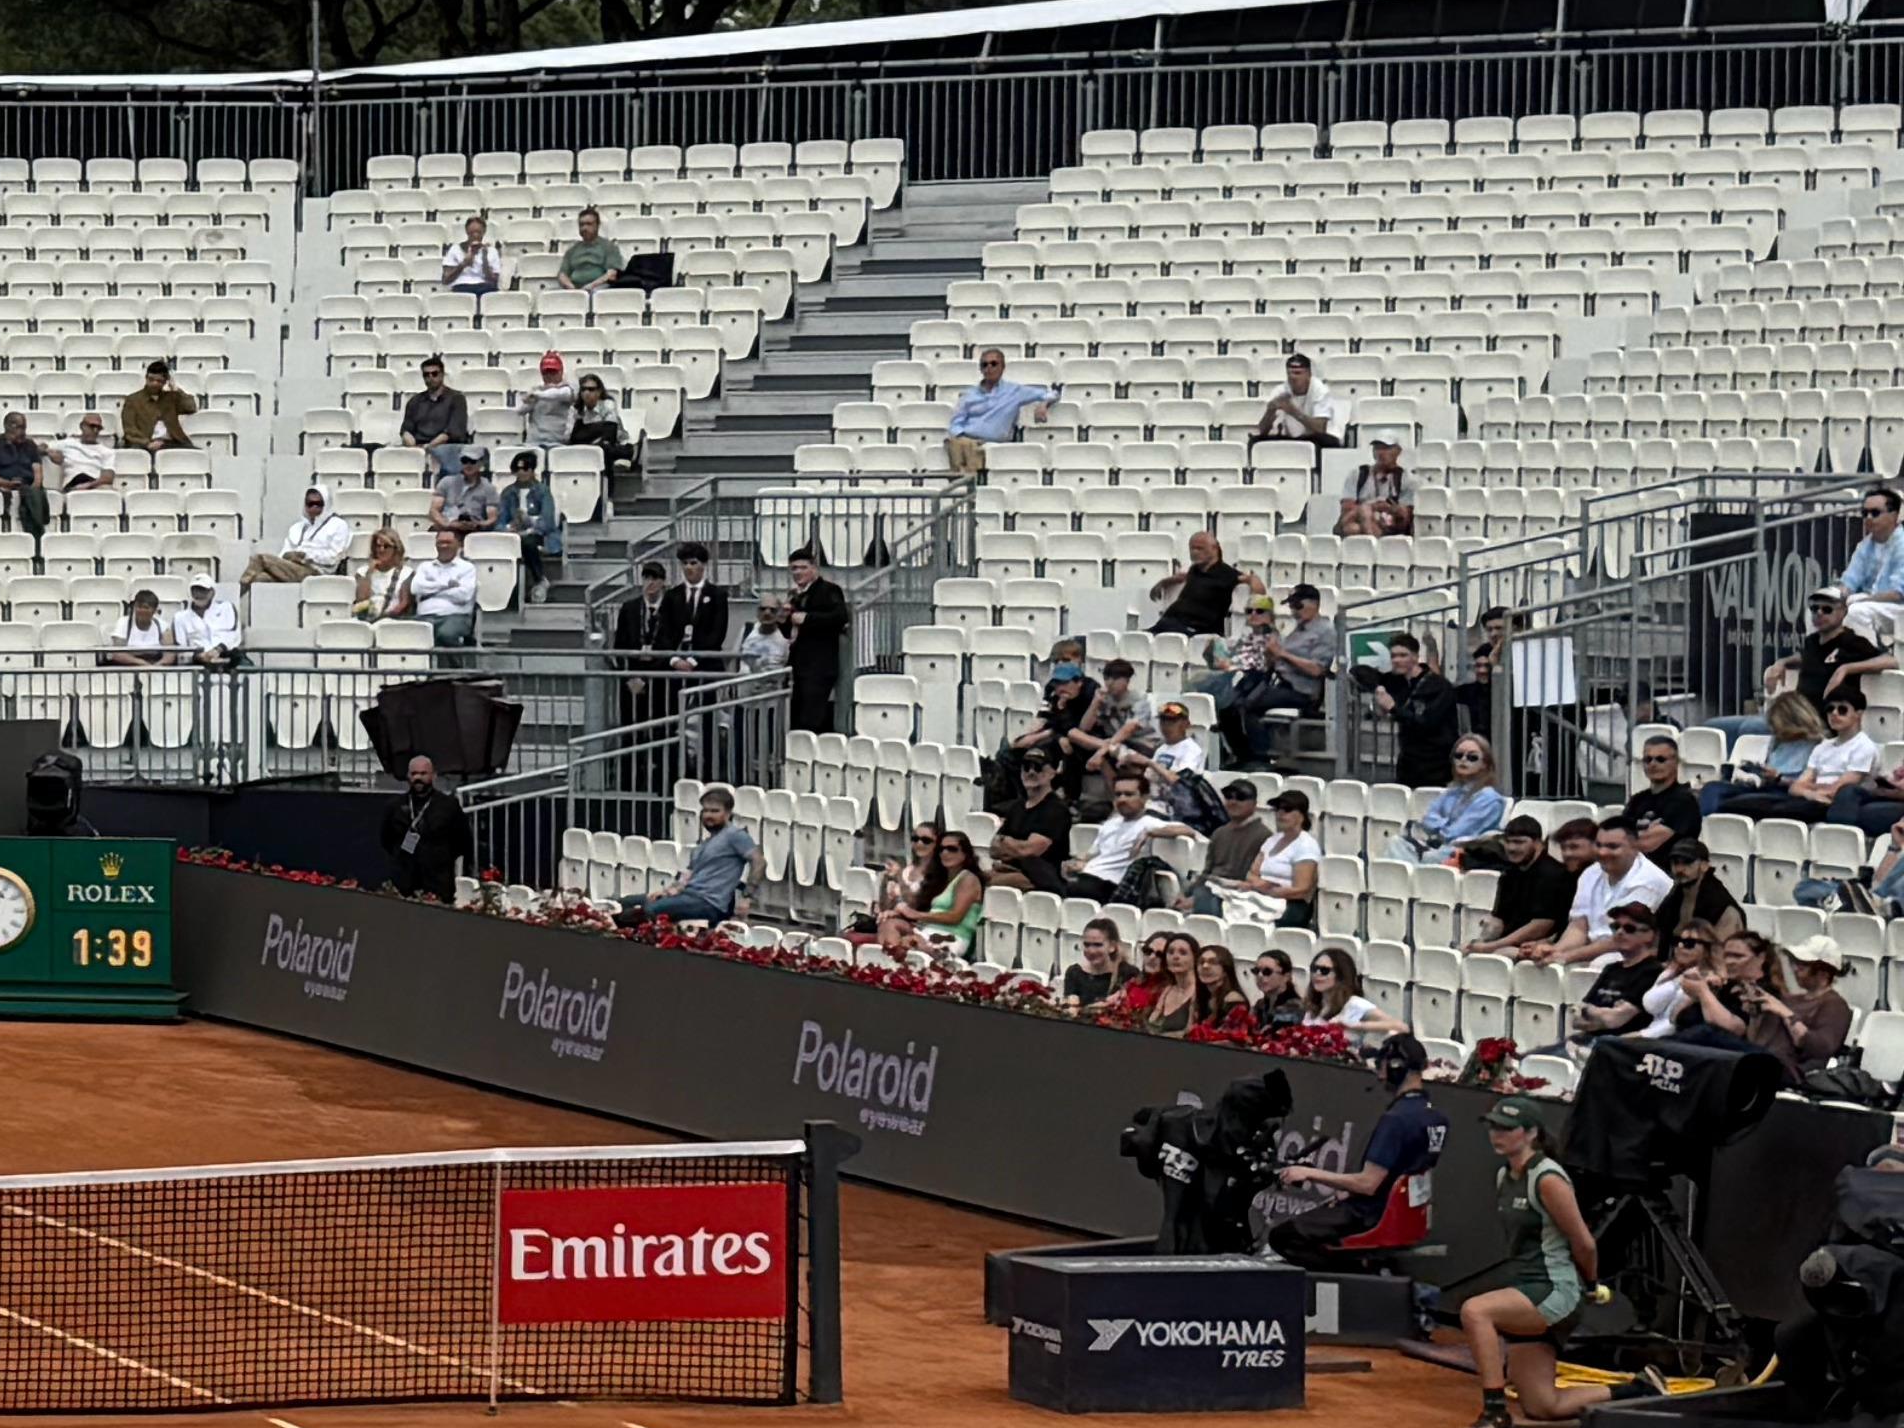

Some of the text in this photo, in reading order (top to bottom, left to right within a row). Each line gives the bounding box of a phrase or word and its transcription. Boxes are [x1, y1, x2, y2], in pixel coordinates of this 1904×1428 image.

[68, 884, 155, 903] ROLEX
[73, 929, 151, 967] 1:39
[261, 913, 359, 982] Polaroid
[499, 961, 616, 1041] Polaroid
[792, 1020, 938, 1114] Polaroid
[859, 1109, 926, 1136] eyewear
[509, 1223, 771, 1281] Emirates
[1135, 1318, 1286, 1347] YOKOHAMA
[1221, 1349, 1286, 1368] TYRES
